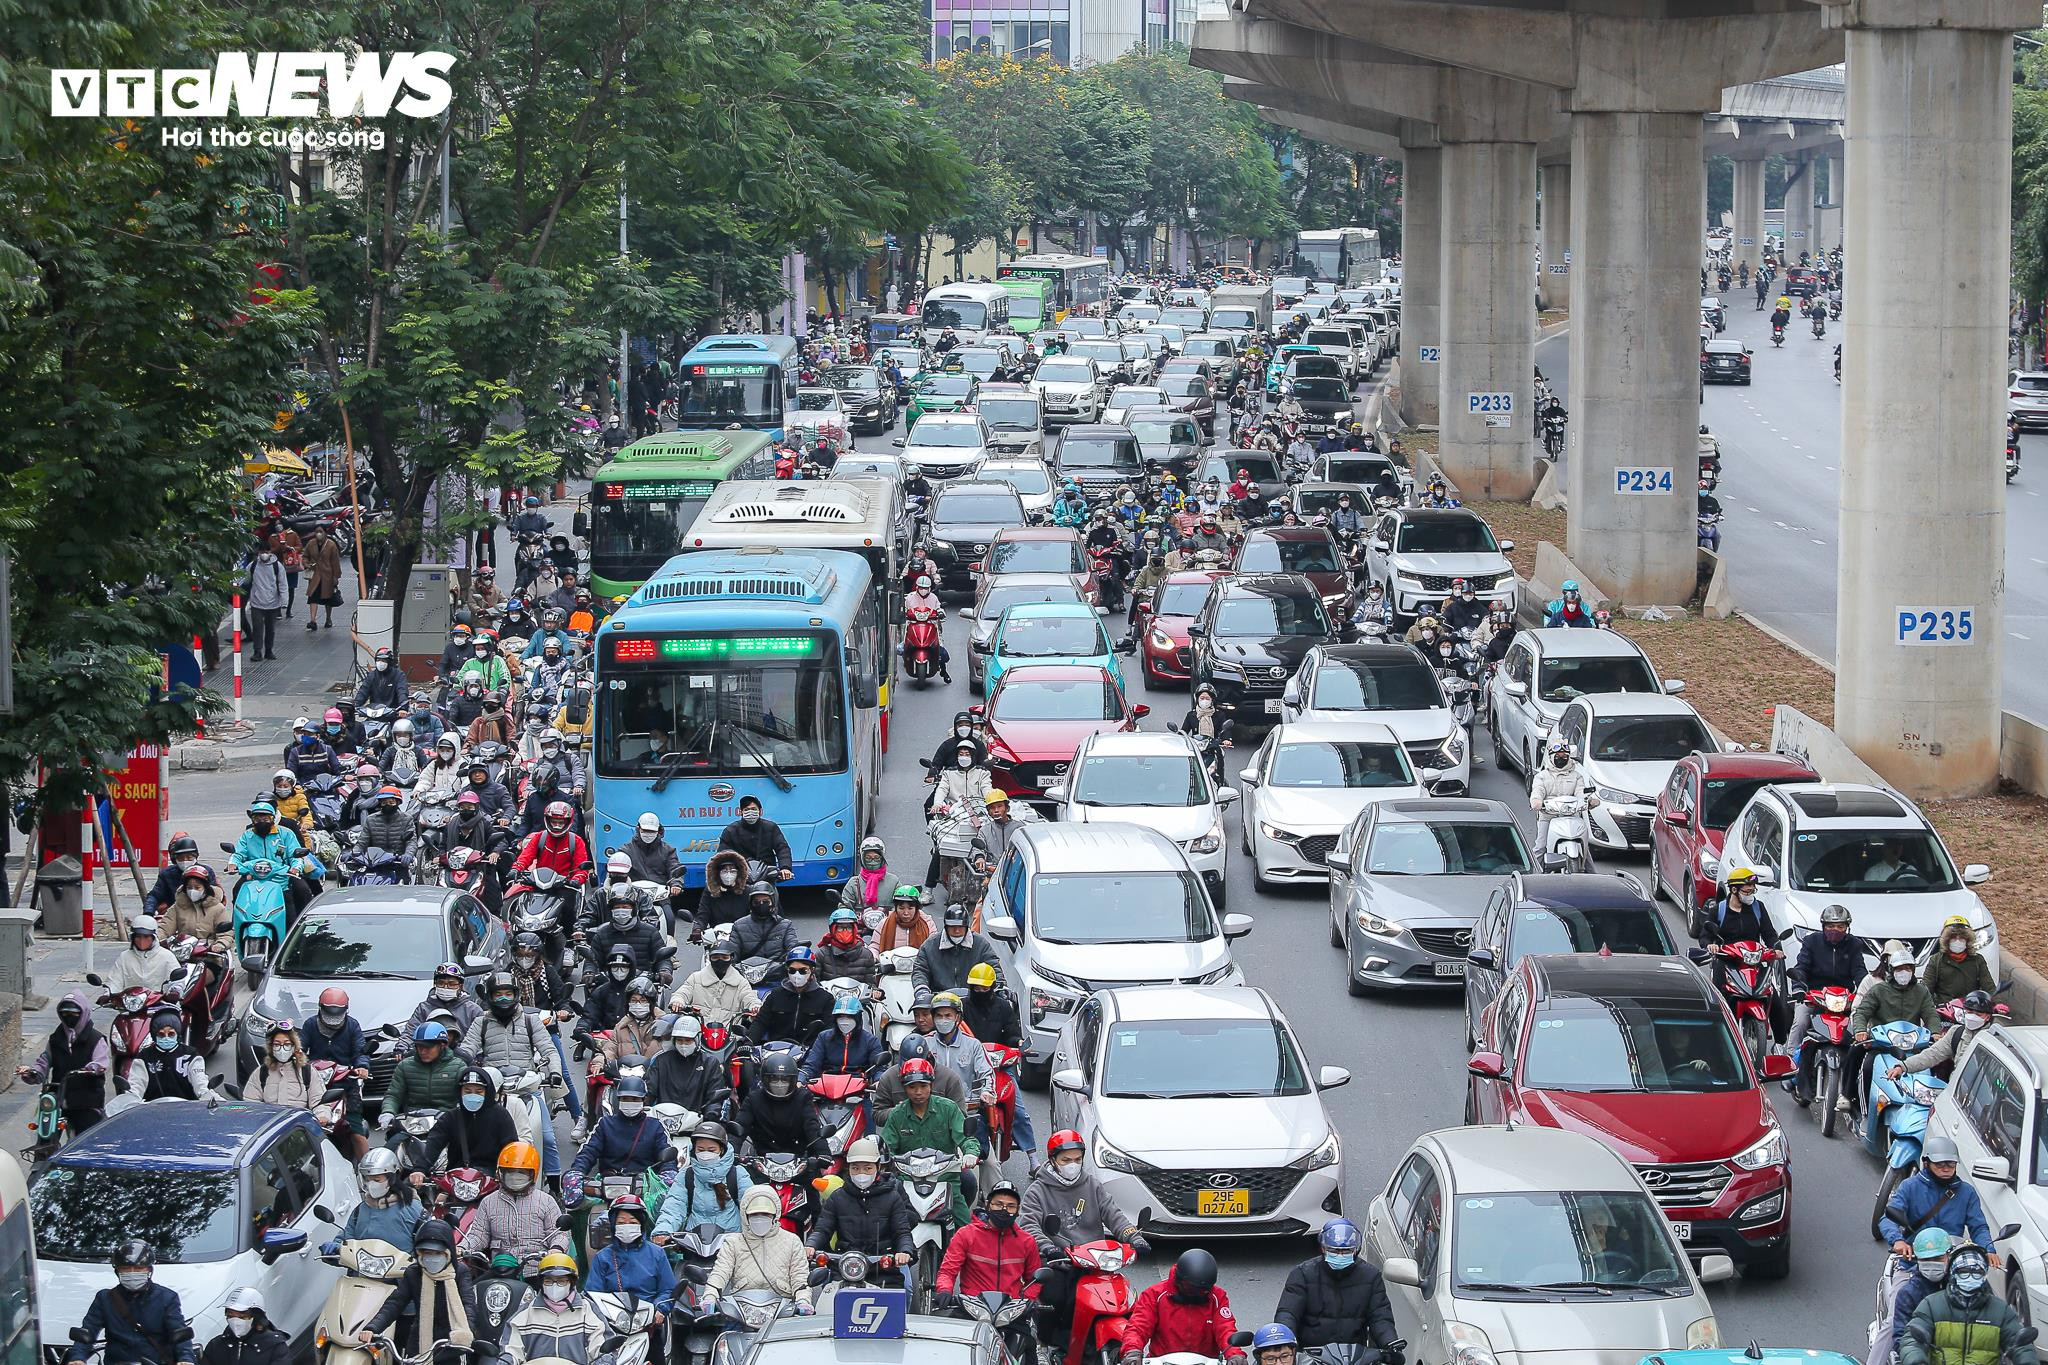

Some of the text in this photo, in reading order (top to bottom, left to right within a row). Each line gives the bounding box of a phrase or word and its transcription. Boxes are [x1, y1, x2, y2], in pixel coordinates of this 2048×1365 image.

[693, 366, 704, 375] 51
[1470, 395, 1512, 412] P233
[1617, 470, 1672, 492] P234
[1899, 611, 1973, 641] P235
[616, 639, 655, 657] 20A
[700, 807, 723, 817] BUS
[1436, 964, 1465, 975] 30A-8
[1212, 1191, 1234, 1202] 29E
[1203, 1203, 1244, 1214] 027.40
[1673, 1224, 1689, 1238] 95
[851, 1297, 888, 1334] G7
[848, 1325, 869, 1333] TAXI
